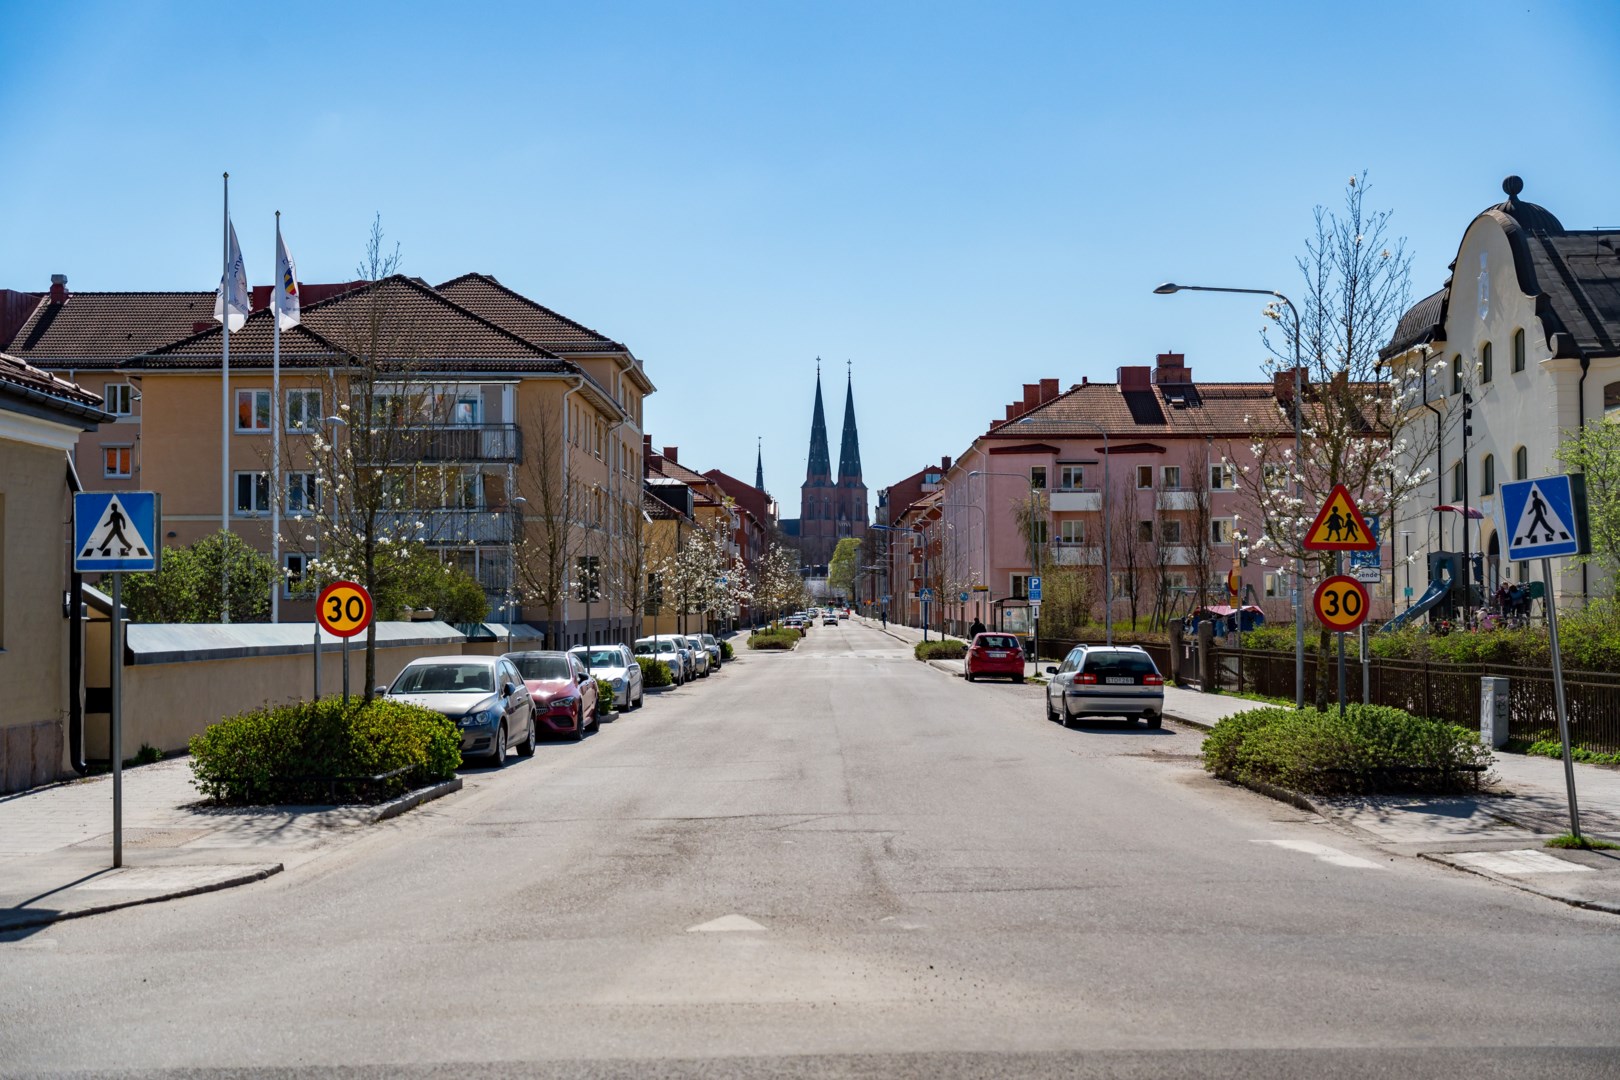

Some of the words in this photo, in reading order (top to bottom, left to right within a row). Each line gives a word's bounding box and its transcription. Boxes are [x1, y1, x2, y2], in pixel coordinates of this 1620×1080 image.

[1032, 578, 1039, 588] P
[327, 596, 364, 622] 30
[1324, 590, 1361, 616] 30
